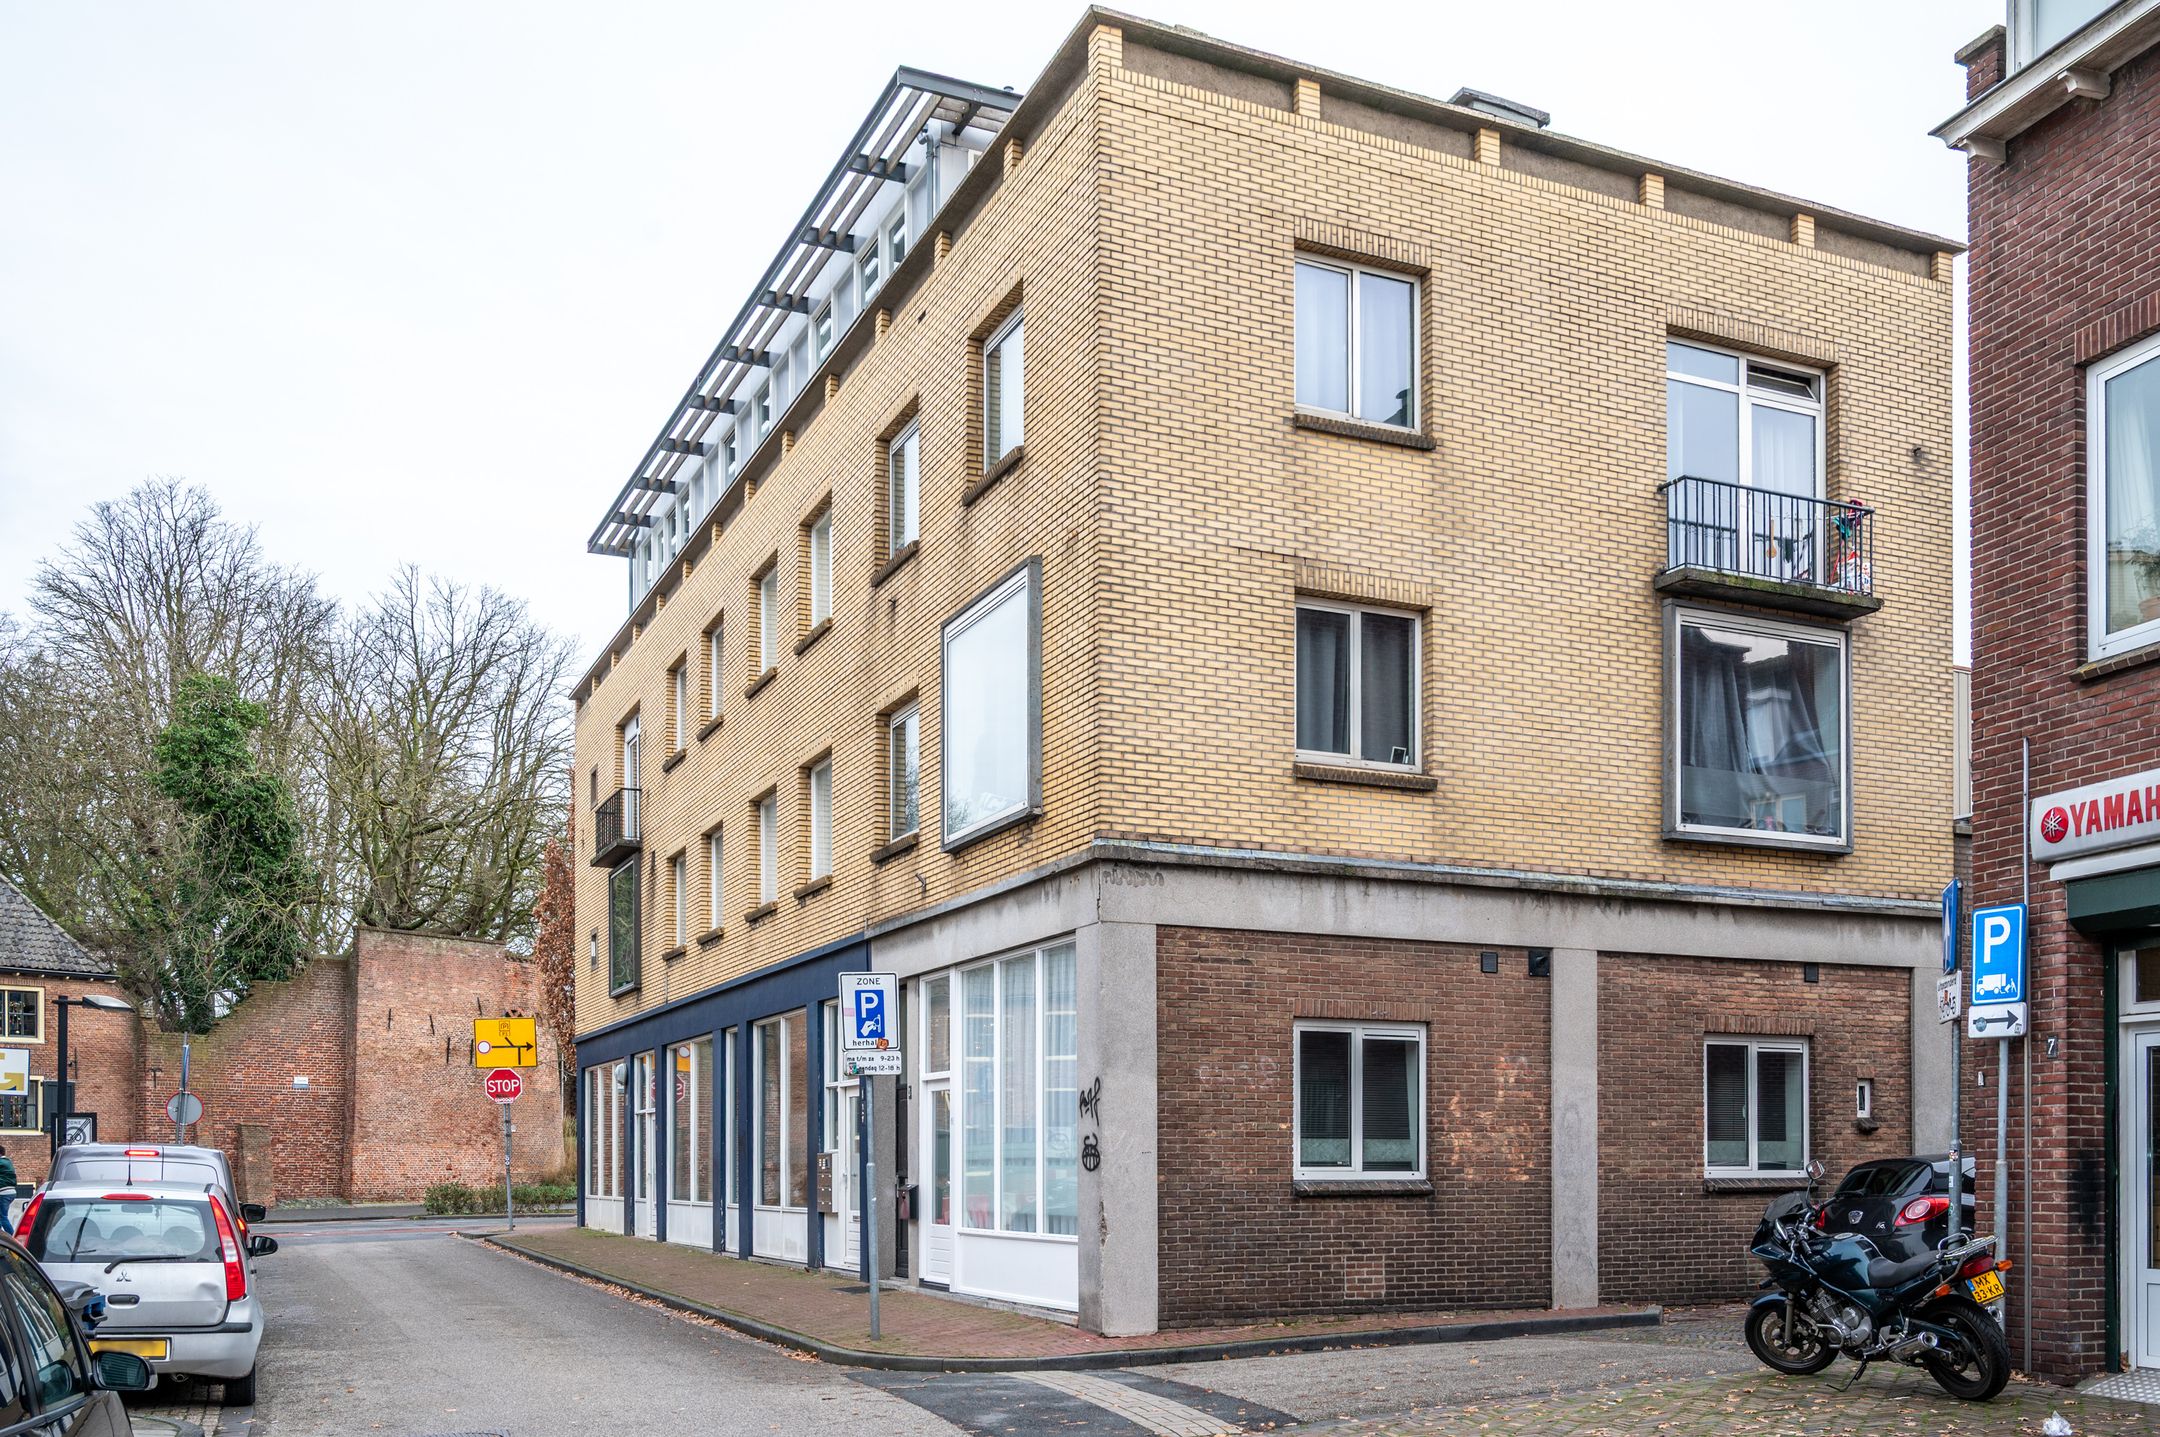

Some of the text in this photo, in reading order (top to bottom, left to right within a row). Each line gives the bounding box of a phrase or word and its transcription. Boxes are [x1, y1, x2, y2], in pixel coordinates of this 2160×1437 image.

[2070, 784, 2160, 837] YAMAH
[1983, 916, 2011, 964] P
[856, 977, 881, 986] ZONE
[860, 992, 879, 1019] P
[852, 1039, 877, 1047] herhal
[2047, 1038, 2056, 1055] 7
[487, 1079, 520, 1093] STOP
[1974, 1283, 2003, 1301] 33-KR
